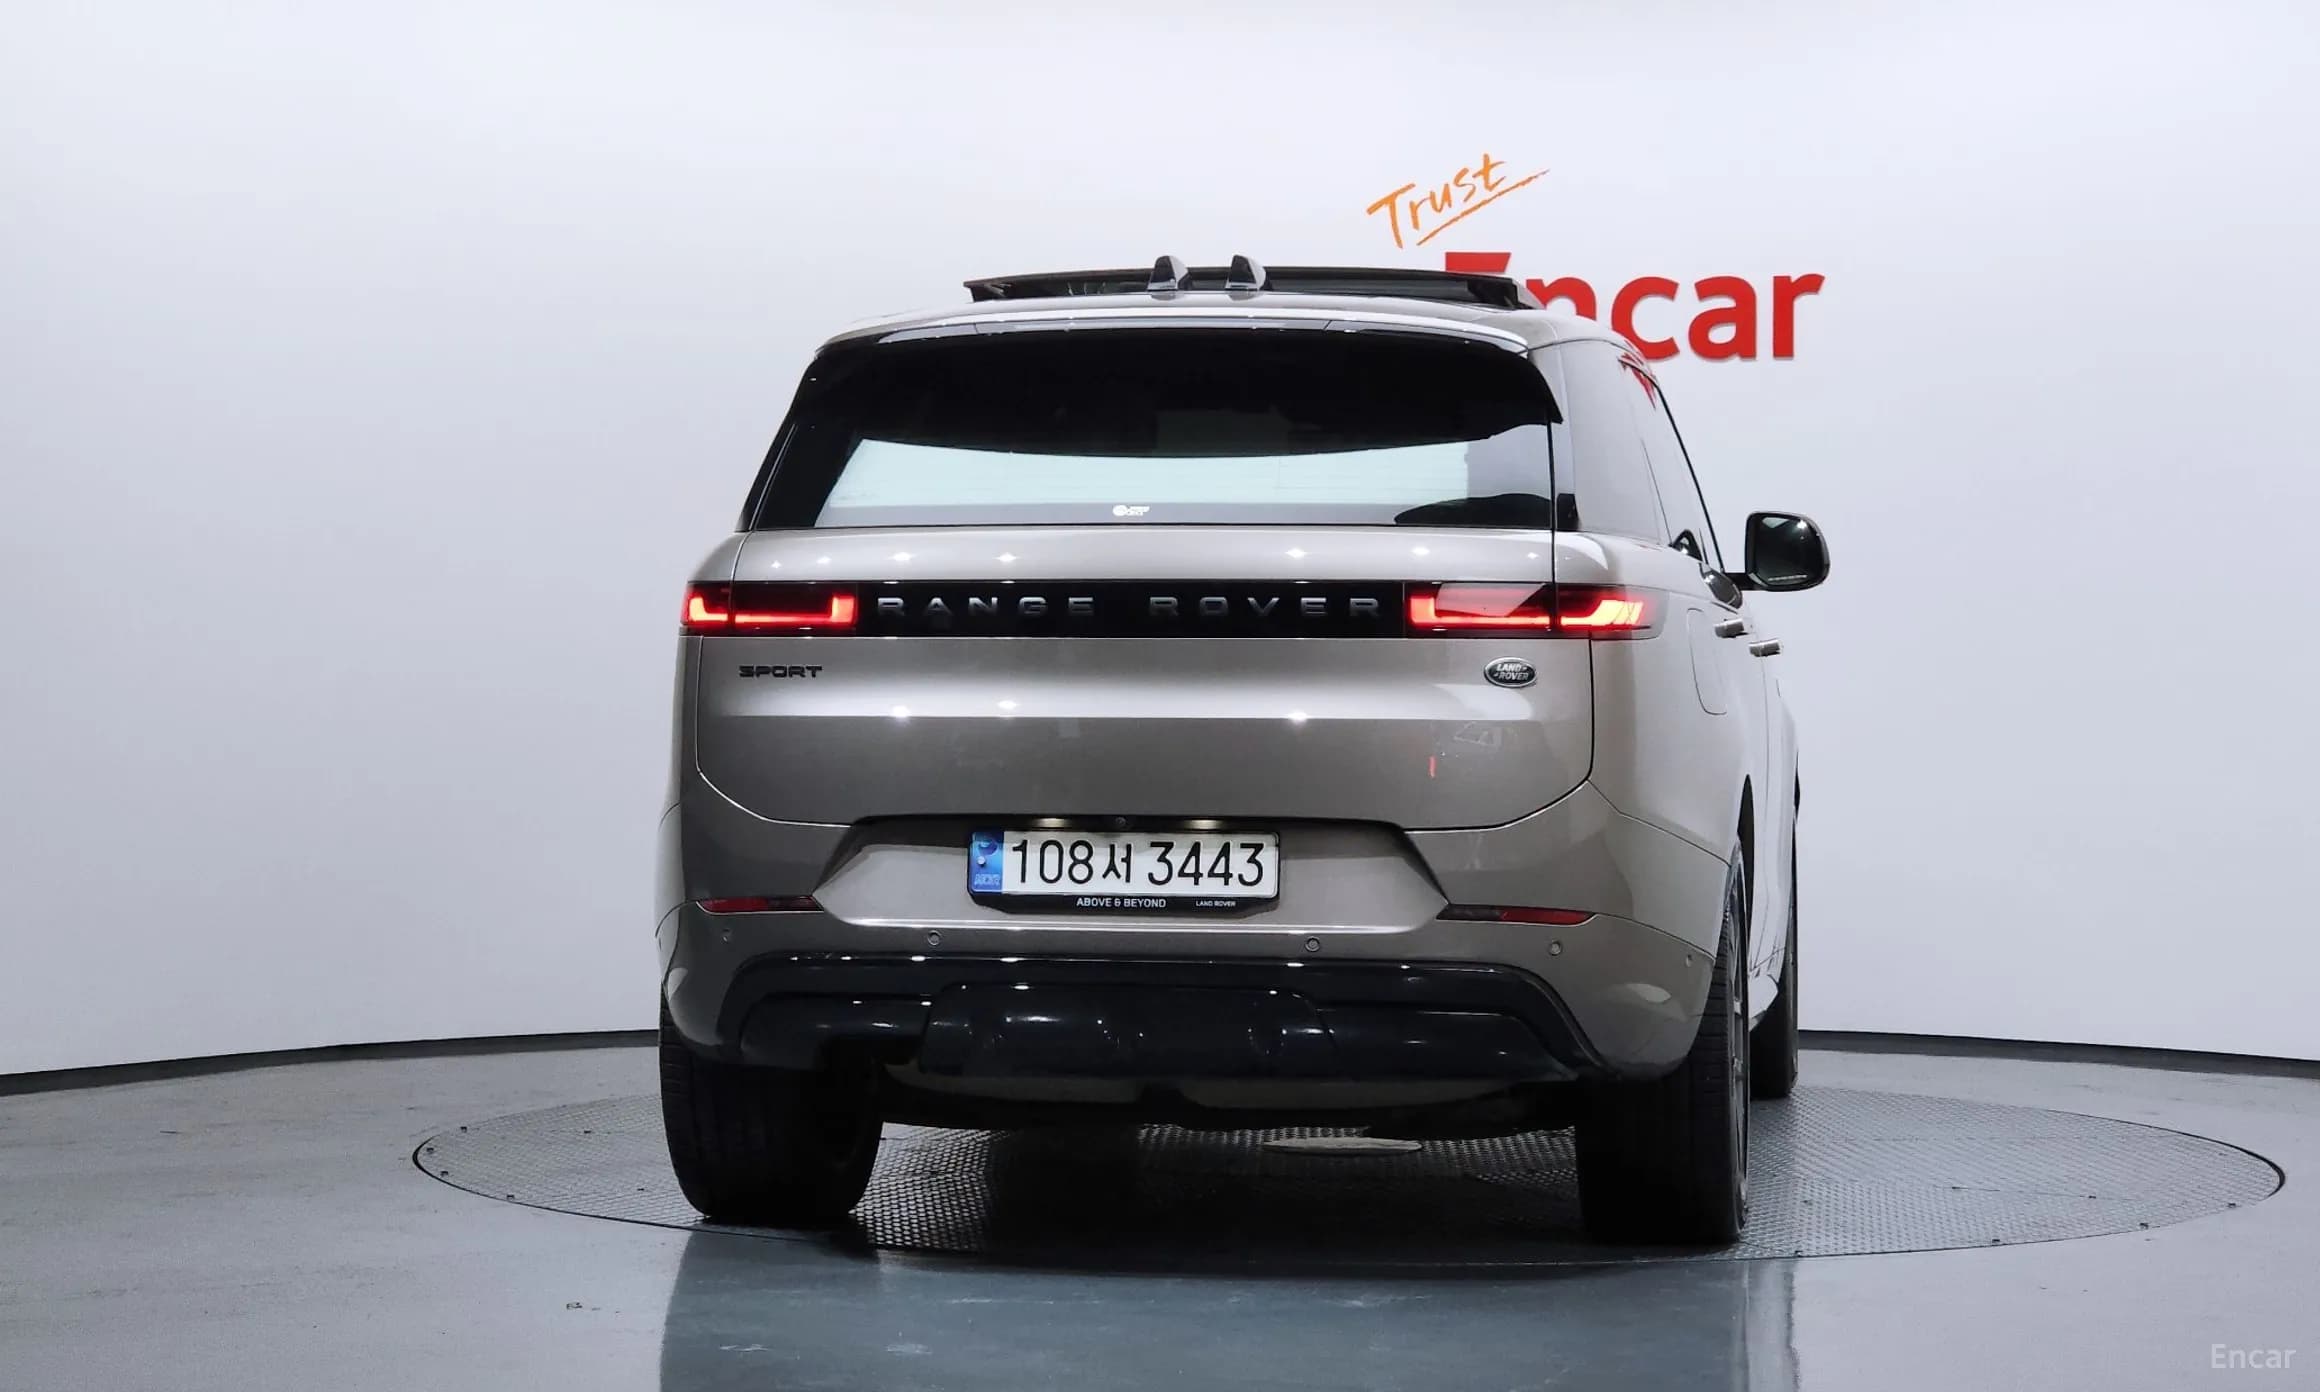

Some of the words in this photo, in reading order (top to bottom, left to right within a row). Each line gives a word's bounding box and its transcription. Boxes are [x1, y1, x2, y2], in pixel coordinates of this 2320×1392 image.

[1367, 153, 1507, 249] Trust
[1445, 251, 1825, 361] ncar
[877, 596, 1094, 616] RANGE
[1150, 596, 1380, 617] ROVER
[739, 665, 823, 678] SPORT
[1496, 663, 1521, 672] LAND
[1499, 671, 1529, 681] ROVER
[1012, 839, 1133, 885] 108서
[1147, 841, 1265, 887] 3443
[1076, 897, 1112, 908] ABOVE
[1114, 898, 1121, 908] &
[1123, 898, 1167, 909] BEYOND
[1195, 900, 1213, 908] LAND
[1214, 900, 1237, 908] ROVER
